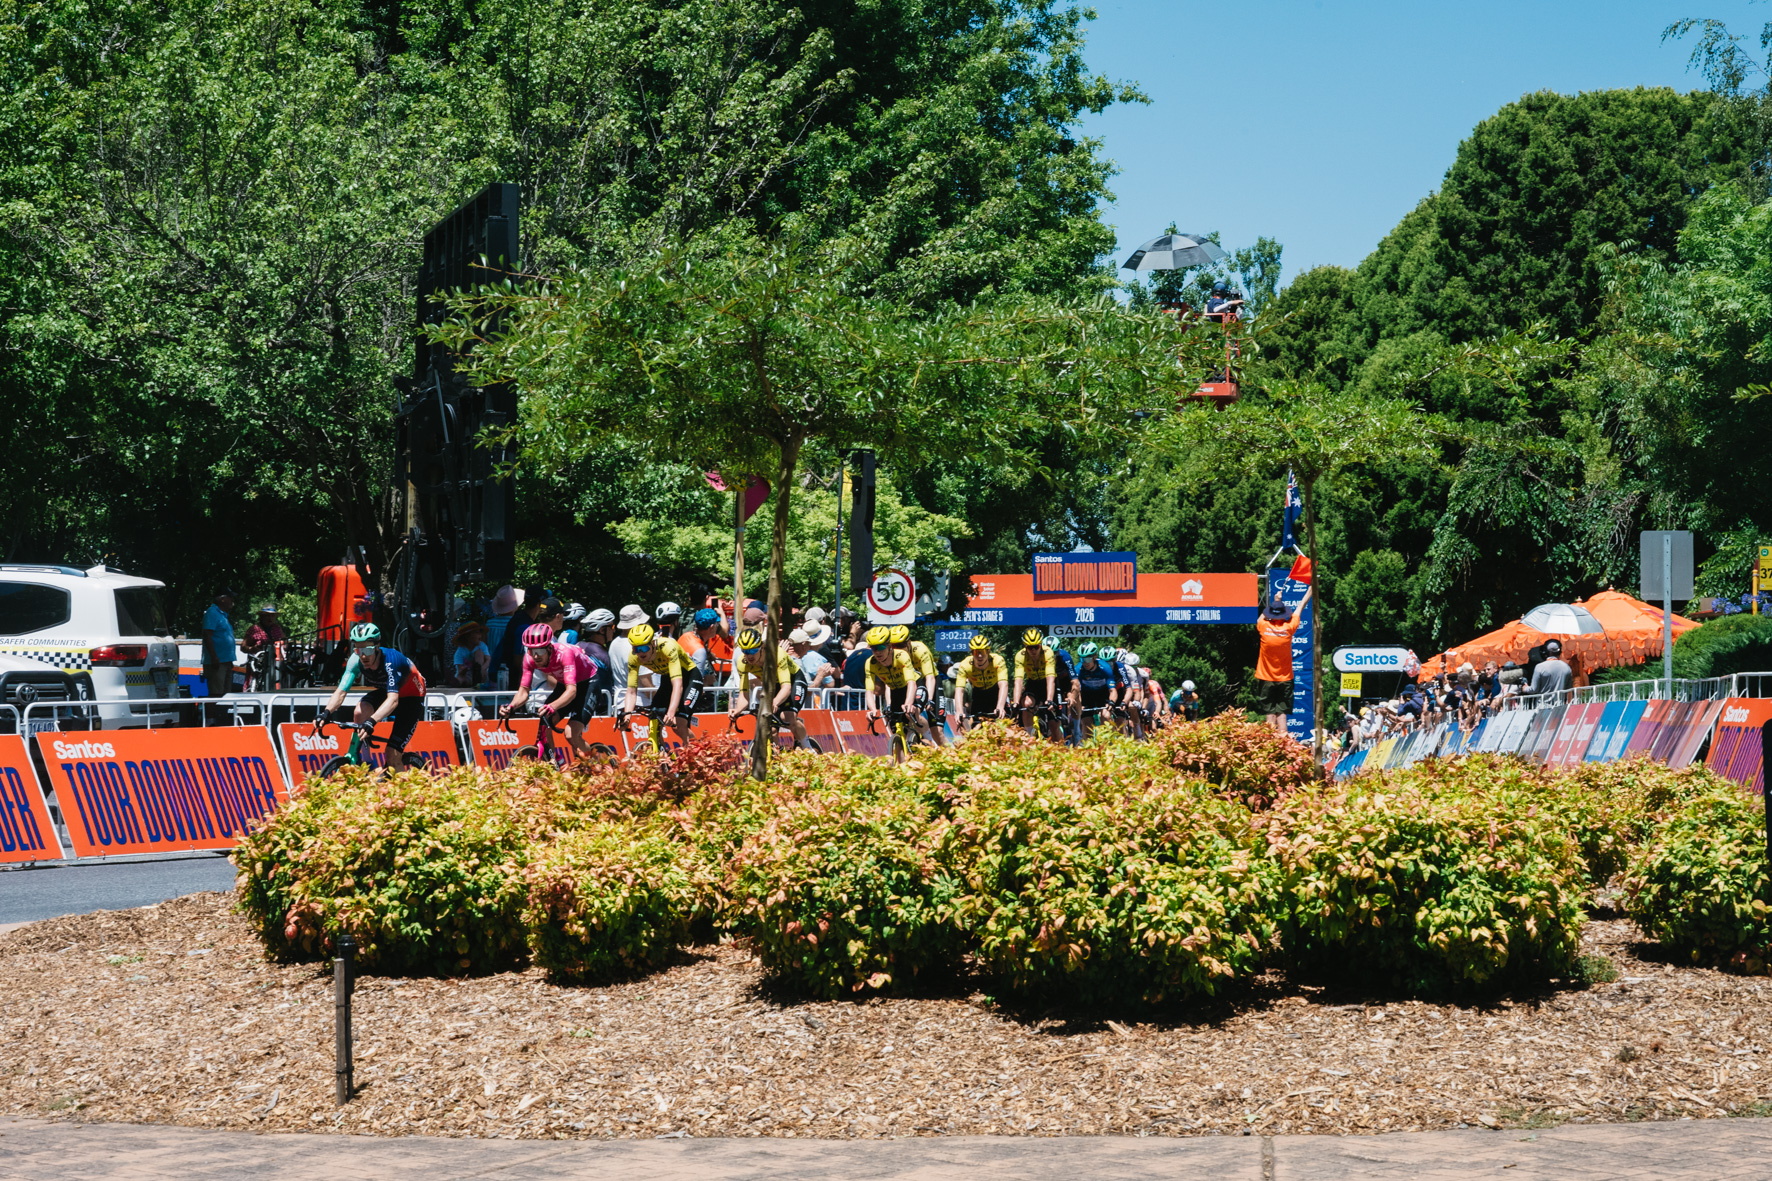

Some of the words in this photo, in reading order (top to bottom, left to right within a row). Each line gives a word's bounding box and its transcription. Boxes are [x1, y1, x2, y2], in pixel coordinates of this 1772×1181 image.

[1034, 555, 1063, 563] Santos
[1034, 563, 1063, 592] TOUR
[1064, 562, 1098, 592] DOWN
[1098, 562, 1134, 591] UNDER
[877, 581, 906, 602] 50
[998, 610, 1003, 622] 5
[1075, 607, 1095, 623] 2026
[1166, 609, 1191, 621] STIRLING
[1196, 609, 1221, 621] STIRLING
[940, 631, 973, 640] 3:02:12
[1053, 625, 1115, 636] GARMIN
[27, 639, 87, 647] COMMUNITIES
[1345, 652, 1399, 666] Santos
[385, 662, 396, 687] Adecco
[1722, 705, 1750, 723] Santos
[477, 728, 519, 747] Santos
[631, 722, 668, 739] Sans
[292, 731, 339, 751] Santos
[53, 740, 116, 760] Santos
[61, 762, 144, 846] TOUR
[125, 758, 216, 842] DOWN
[196, 756, 278, 838] UNDER
